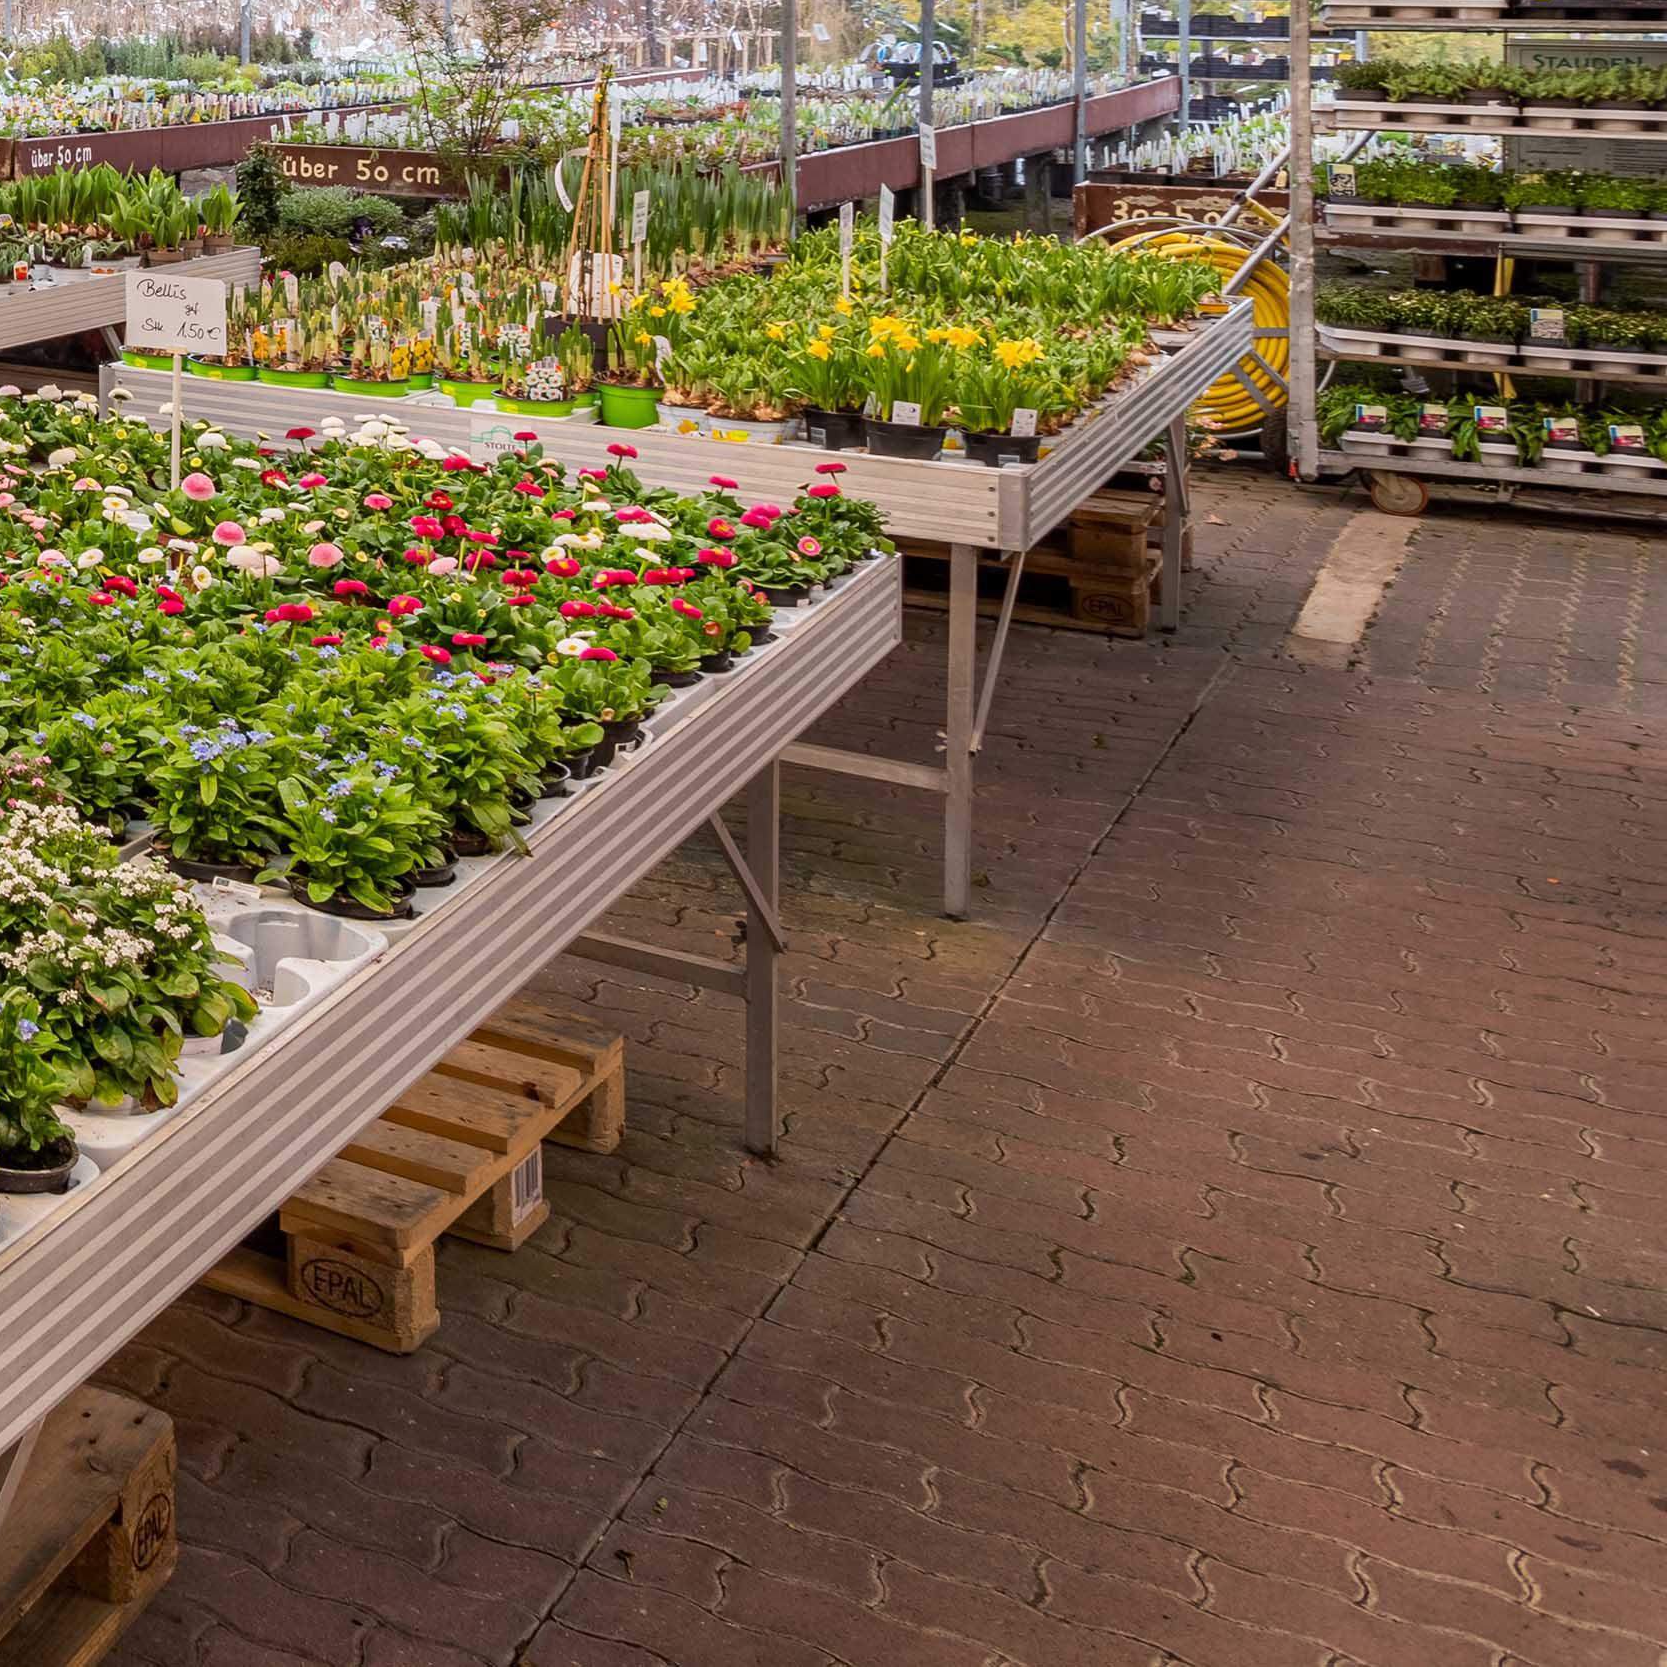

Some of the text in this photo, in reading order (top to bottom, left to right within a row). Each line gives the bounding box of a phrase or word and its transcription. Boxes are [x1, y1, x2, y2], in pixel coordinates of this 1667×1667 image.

[31, 145, 92, 168] über 50 cm
[282, 156, 441, 184] über 50 cm
[136, 278, 187, 300] Bellis
[314, 1265, 373, 1309] EPAL
